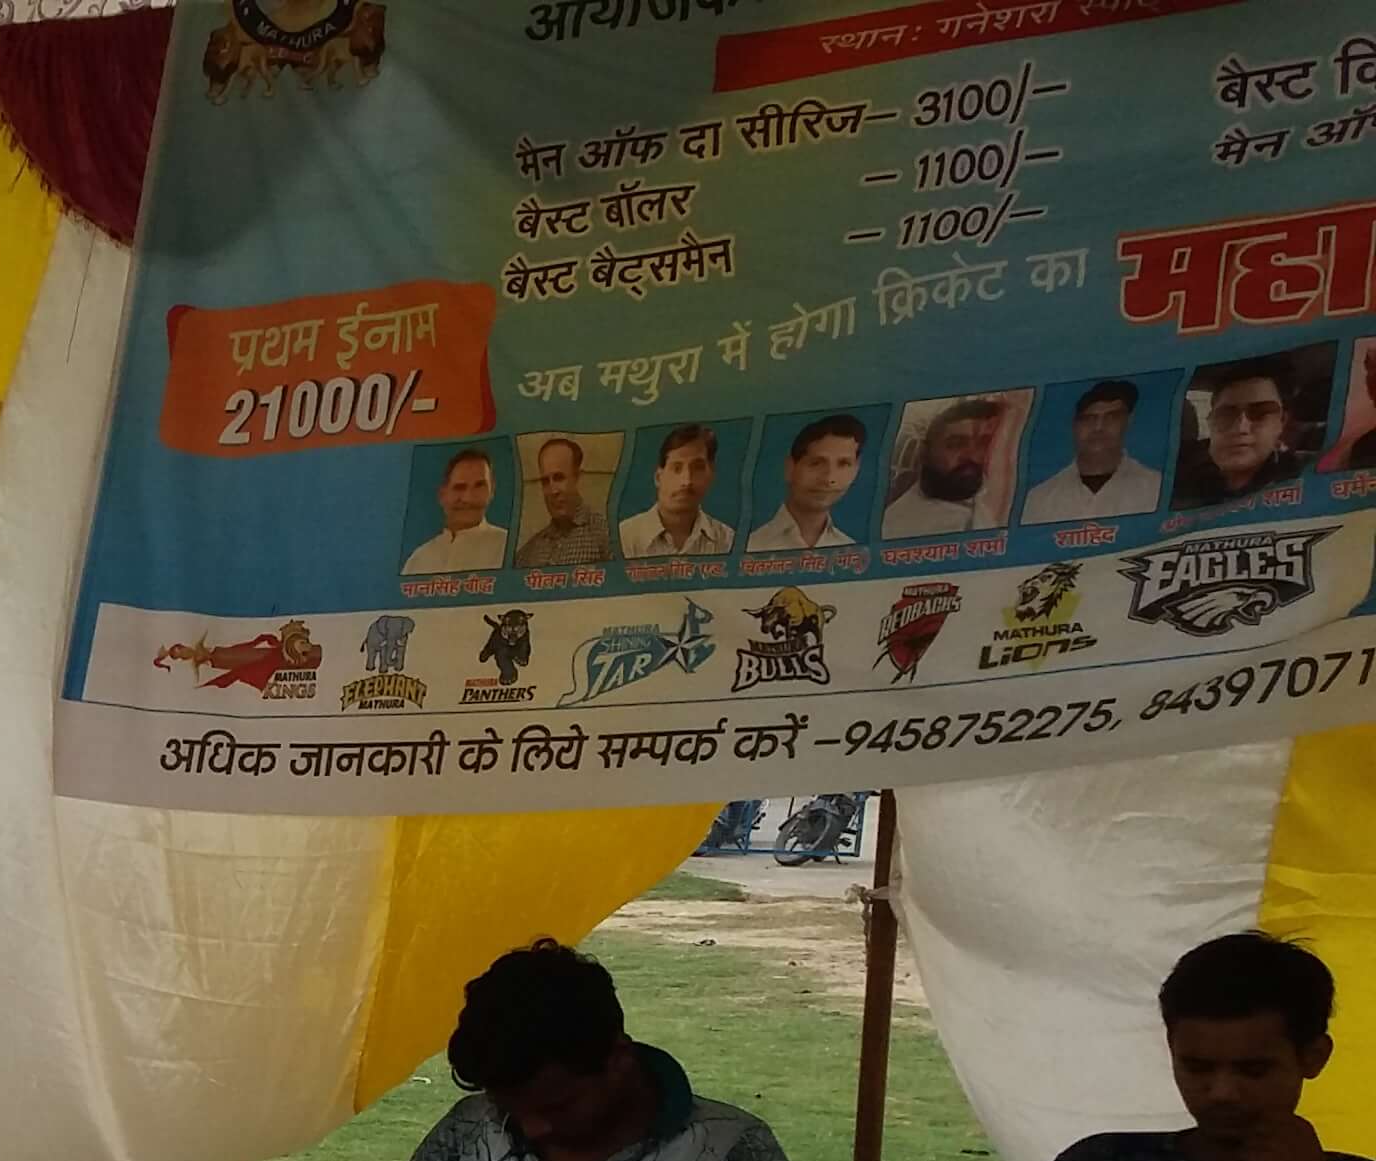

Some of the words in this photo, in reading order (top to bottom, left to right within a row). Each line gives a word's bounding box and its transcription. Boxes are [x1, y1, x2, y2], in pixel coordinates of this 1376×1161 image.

[258, 21, 336, 49] MATHURA
[516, 137, 561, 183] मैन
[577, 126, 665, 171] ऑफ
[680, 121, 719, 160] दा
[914, 61, 1067, 127] 3100/-
[1214, 127, 1286, 166] मैन
[516, 199, 589, 241] बैस्ट
[603, 175, 695, 230] बॉलर
[505, 255, 577, 300] बैस्ट
[230, 319, 323, 377] प्रथम
[337, 303, 438, 369] ईनाम
[518, 363, 578, 402] अब
[596, 345, 699, 405] मथुरा
[718, 321, 750, 372] में
[768, 295, 855, 361] होगा
[873, 252, 1008, 328] क्रिकेट
[1027, 247, 1089, 290] का
[218, 369, 439, 444] 21000/-
[964, 531, 1007, 559] शर्मा
[1054, 524, 1117, 549] शाहिद
[1185, 535, 1272, 555] MATHURA
[1140, 537, 1308, 609] EAGLES
[993, 620, 1083, 642] MATHURA
[275, 671, 317, 682] MATHURA
[732, 647, 830, 692] BULLS
[262, 682, 316, 699] KINGS
[341, 674, 427, 712] ELEPHANT
[358, 698, 405, 711] MATHURA
[461, 686, 537, 702] PANTHERS
[159, 730, 280, 777] अधिक
[289, 726, 449, 777] जानकारी
[457, 727, 498, 774] के
[509, 723, 587, 772] लिये
[596, 718, 727, 769] सम्पर्क
[733, 713, 809, 761] करें
